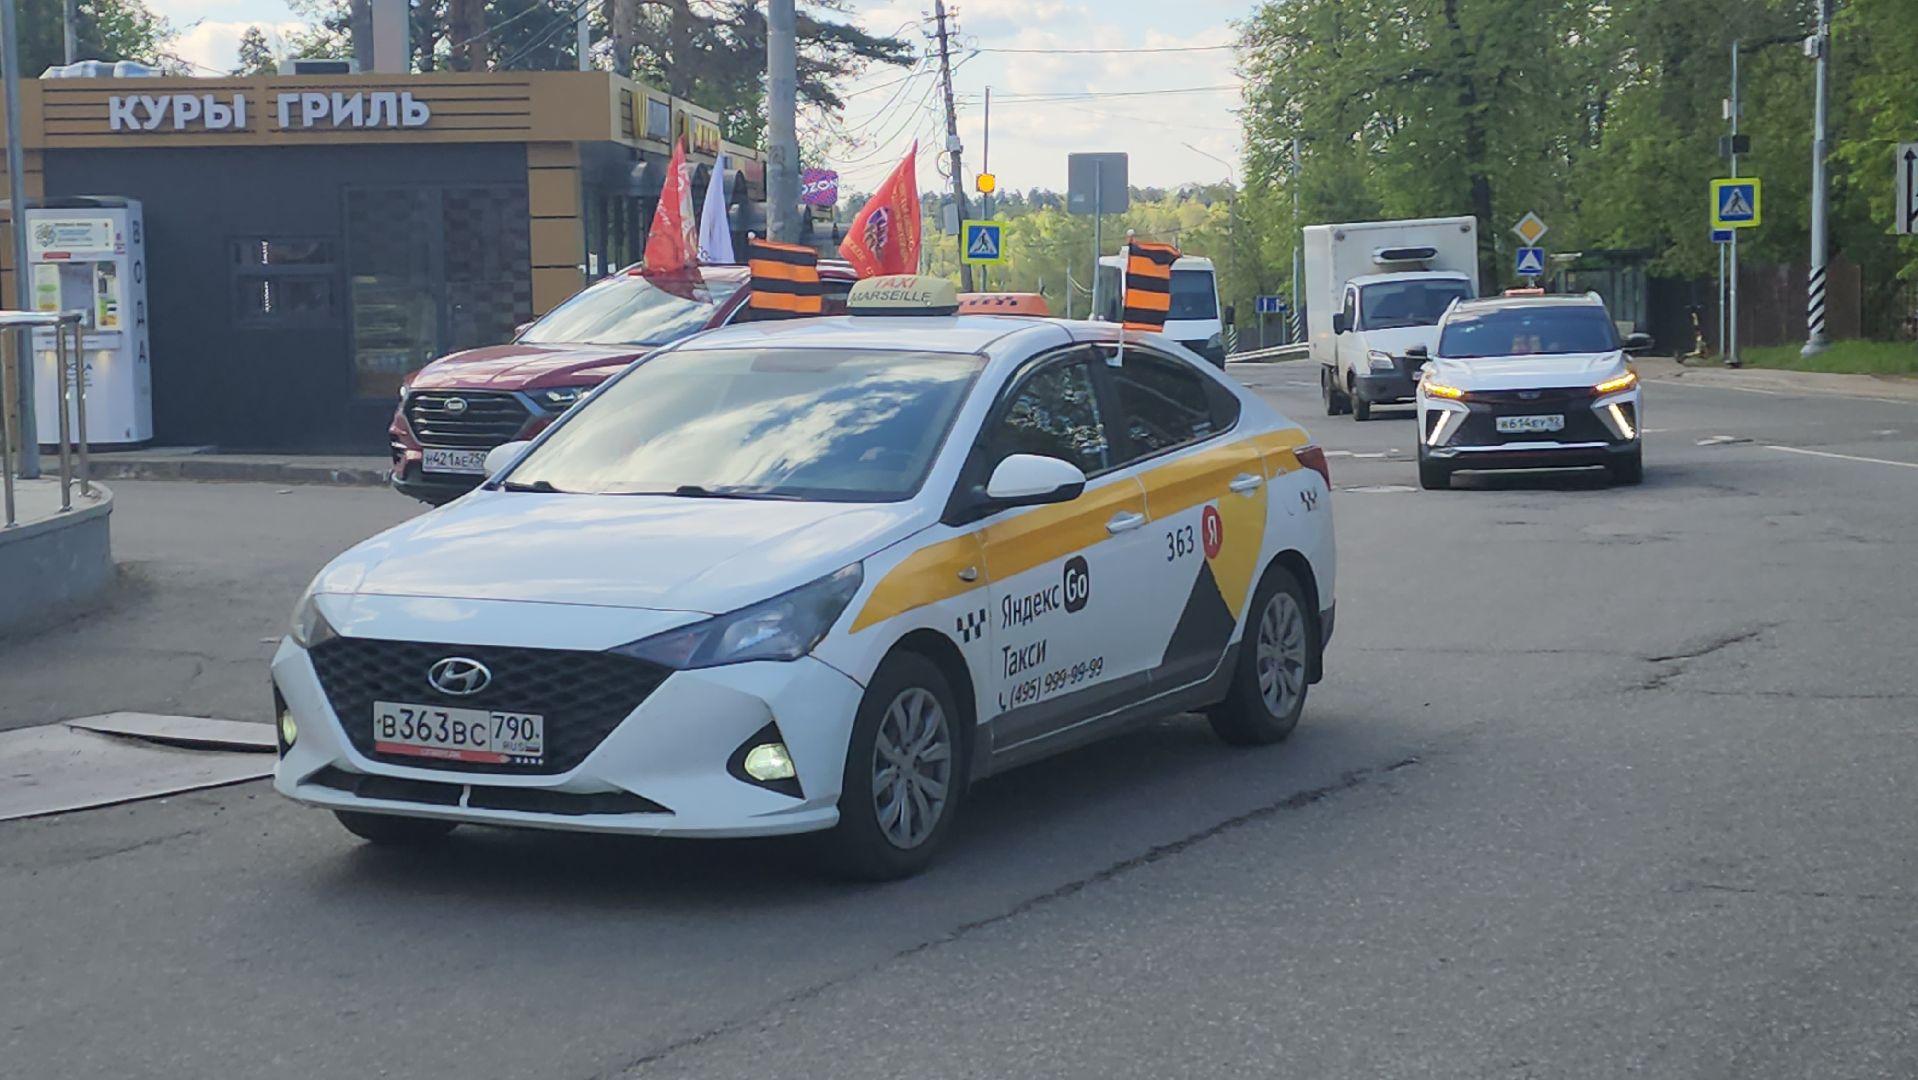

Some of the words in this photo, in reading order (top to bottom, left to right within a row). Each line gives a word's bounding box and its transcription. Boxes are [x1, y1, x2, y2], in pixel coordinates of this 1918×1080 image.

[109, 94, 246, 130] КУРЫ
[277, 92, 431, 128] ГРИЛЬ
[132, 219, 148, 363] ВОДА
[851, 289, 932, 303] MARSEILLE
[873, 276, 918, 288] TAXI
[1166, 525, 1194, 562] 363
[1207, 515, 1218, 546] Я
[1001, 584, 1060, 630] Яндекс
[1065, 568, 1088, 603] Go
[1001, 639, 1047, 680] Такси
[1010, 676, 1041, 709] (495)
[1044, 656, 1104, 694] 999-99-99
[382, 708, 486, 747] В363ВС
[492, 715, 534, 742] 790
[502, 741, 526, 751] RUS
